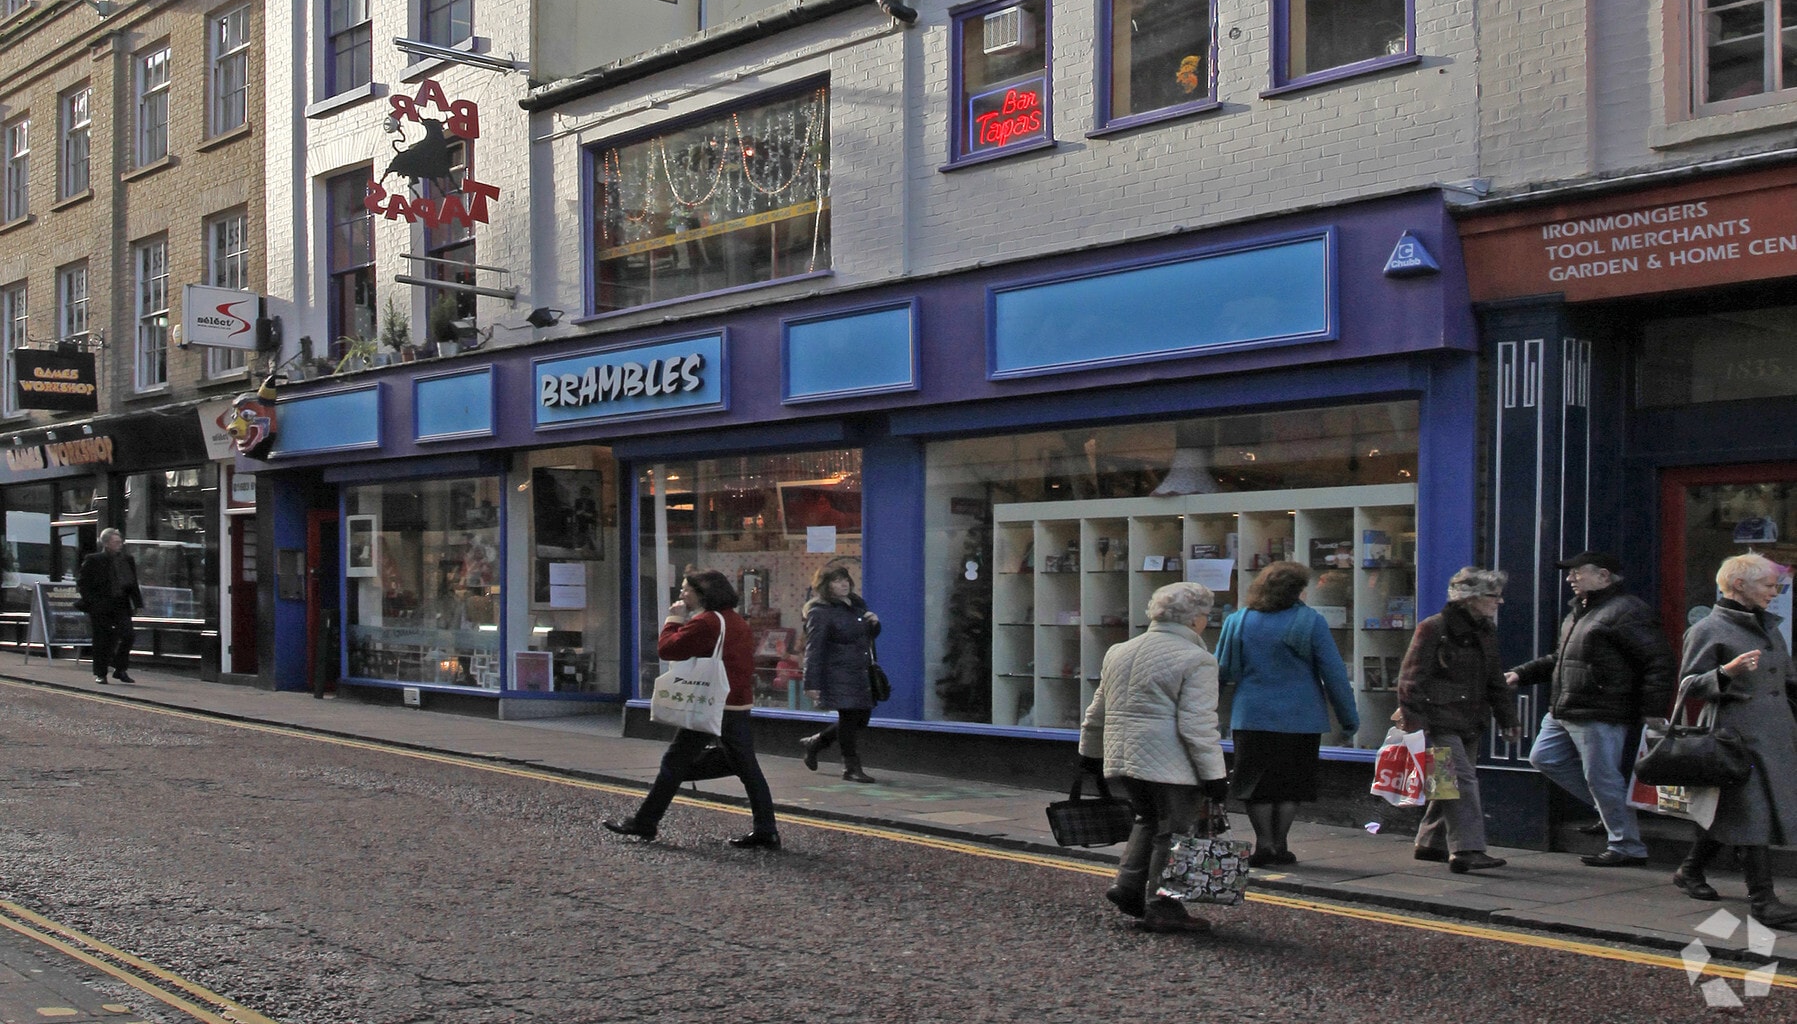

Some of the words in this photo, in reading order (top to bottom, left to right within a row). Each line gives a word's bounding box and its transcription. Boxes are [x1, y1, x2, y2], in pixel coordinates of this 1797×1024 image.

[1002, 88, 1039, 115] Bar
[975, 109, 1043, 148] Tapas
[1542, 201, 1709, 240] IRONMONGERS
[1545, 240, 1606, 261] TOOL
[1611, 217, 1751, 253] MERCHANTS
[1391, 258, 1421, 268] Chubb
[1548, 256, 1639, 282] GARDEN
[1646, 253, 1663, 270] &
[1669, 243, 1741, 267] HOME
[19, 380, 95, 395] WORKSHOP
[33, 366, 79, 380] GAMES
[541, 352, 705, 408] BRAMBLES
[45, 435, 113, 467] WORKSHOP
[1379, 767, 1420, 794] Sale
